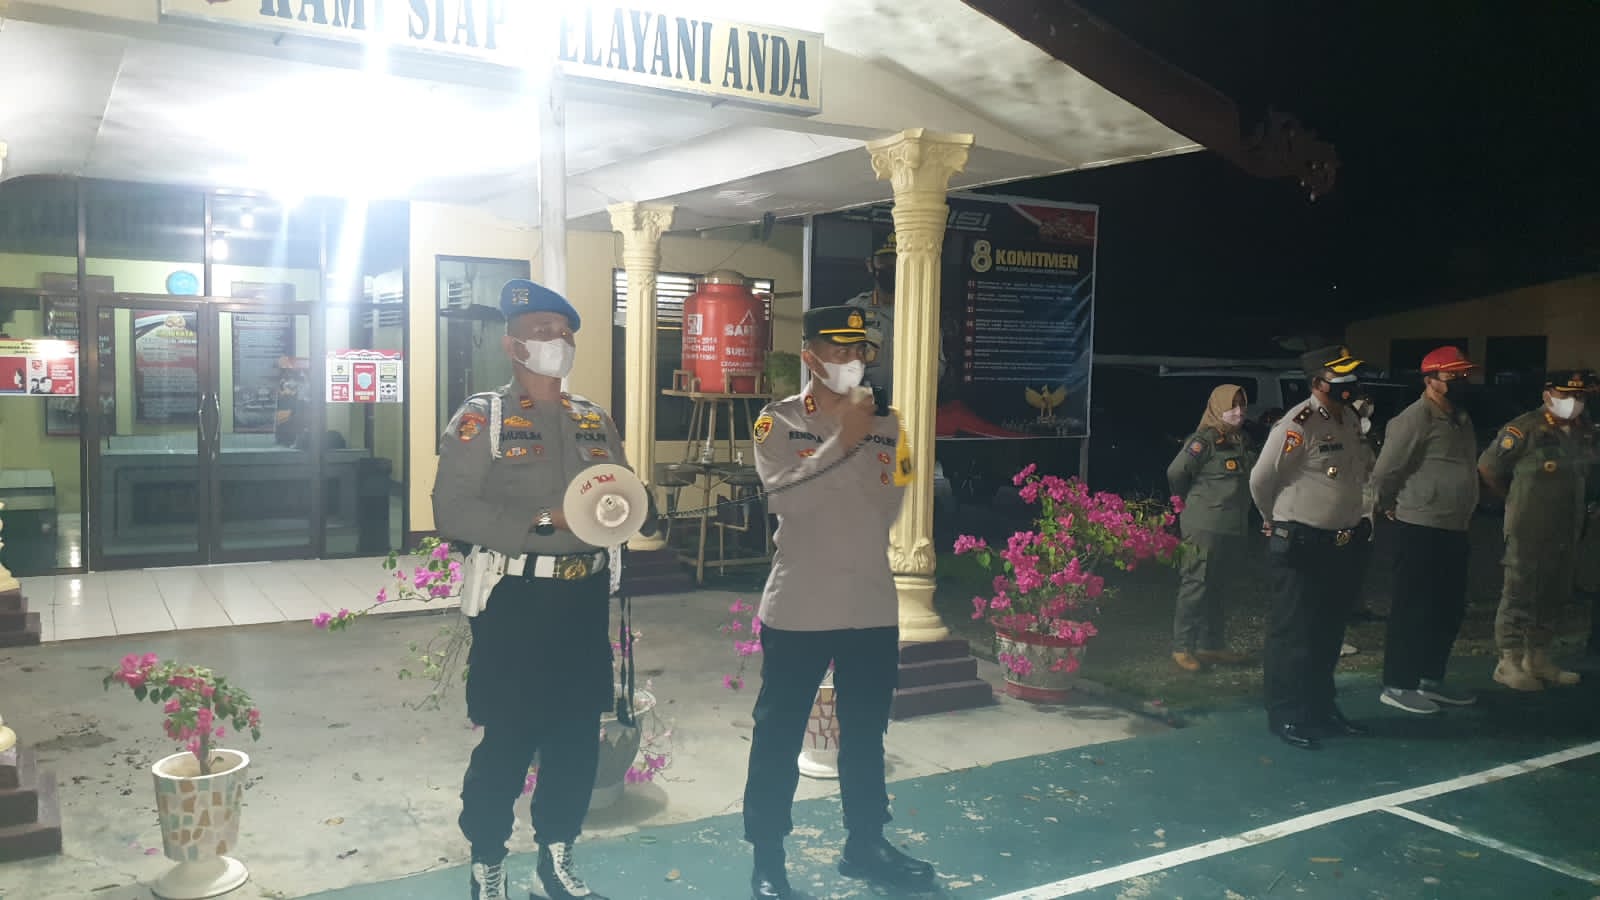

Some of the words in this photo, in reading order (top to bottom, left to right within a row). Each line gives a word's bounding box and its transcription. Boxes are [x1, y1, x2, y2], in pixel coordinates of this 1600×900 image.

[550, 0, 713, 84] ELAYANI
[722, 27, 810, 100] ANDA
[970, 239, 992, 273] 8
[995, 249, 1079, 269] KOMITMEN
